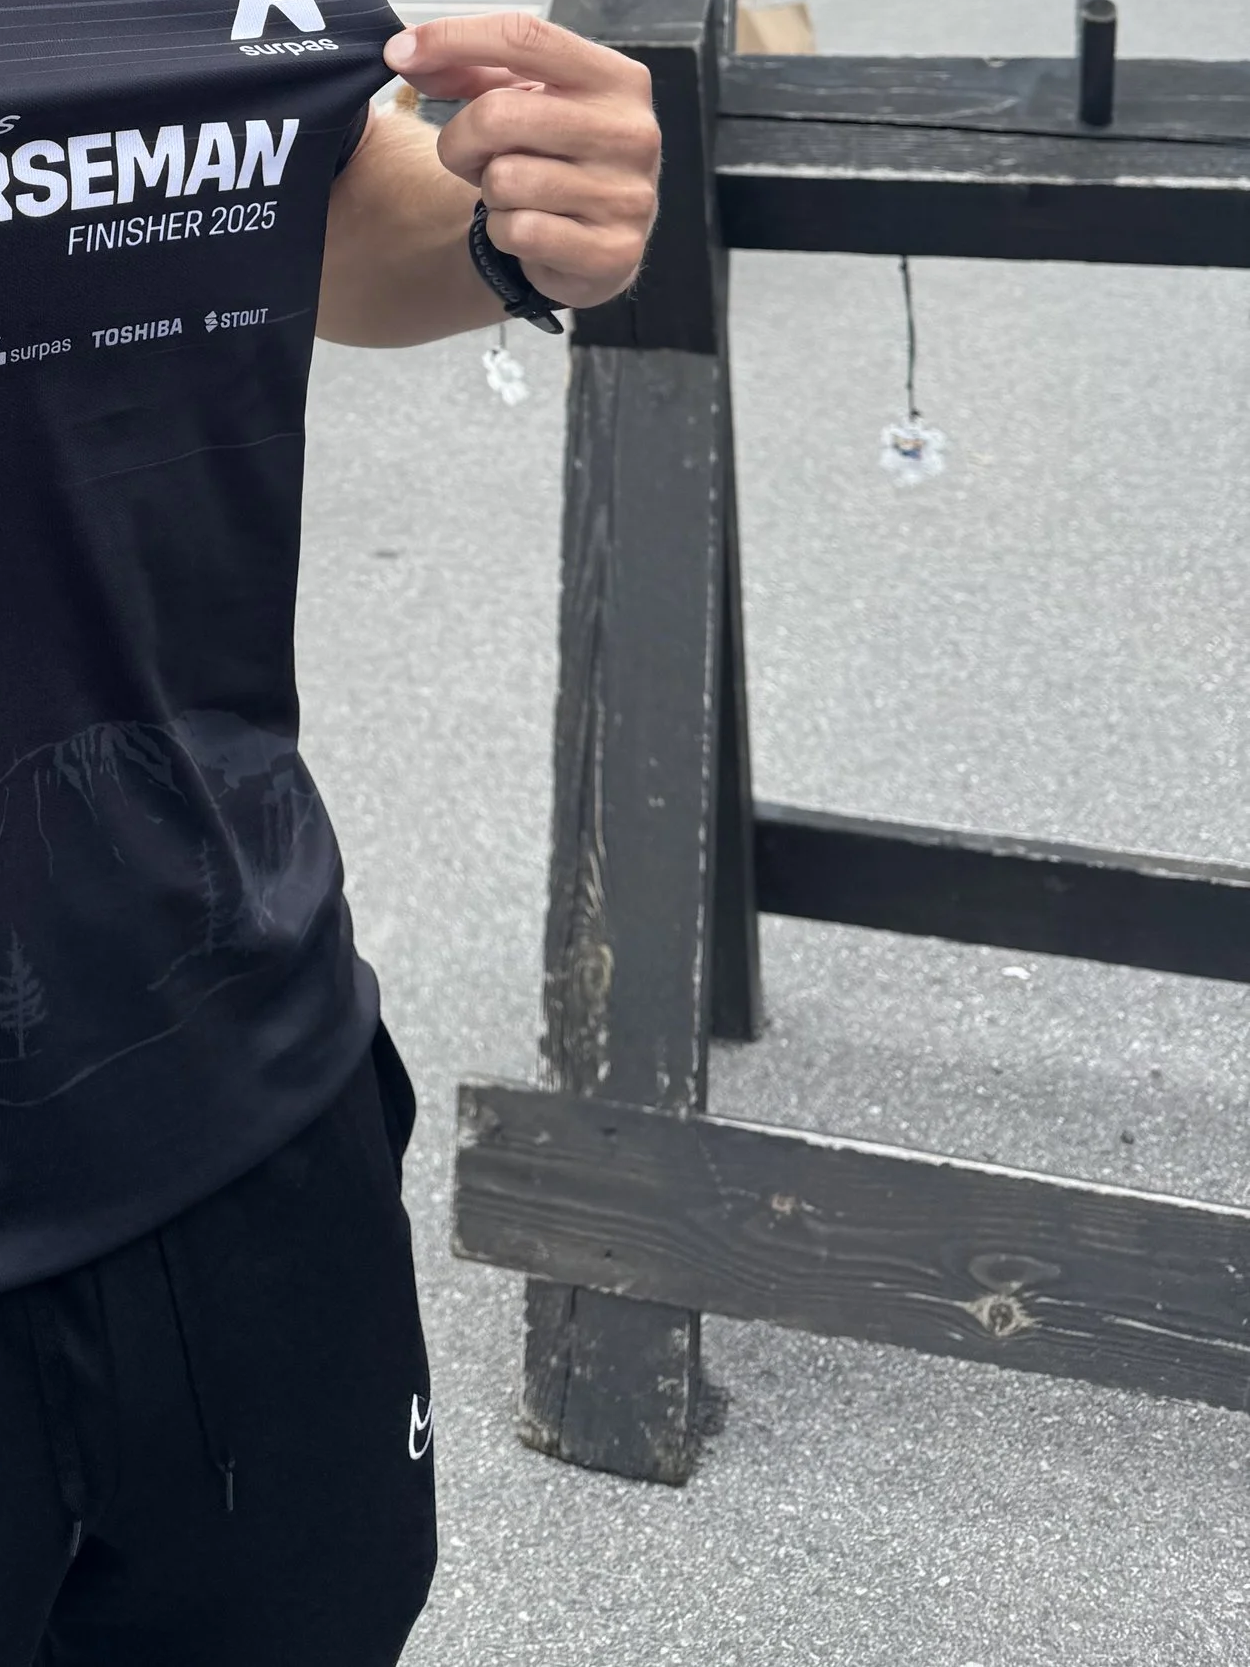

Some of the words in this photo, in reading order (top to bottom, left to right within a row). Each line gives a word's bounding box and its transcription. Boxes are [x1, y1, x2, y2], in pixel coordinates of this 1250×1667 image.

[239, 38, 339, 56] surpas
[68, 210, 203, 256] FINISHER
[209, 201, 278, 235] 2025
[220, 308, 269, 328] STOUT
[92, 317, 183, 348] TOSHIBA
[10, 337, 72, 364] surpas
